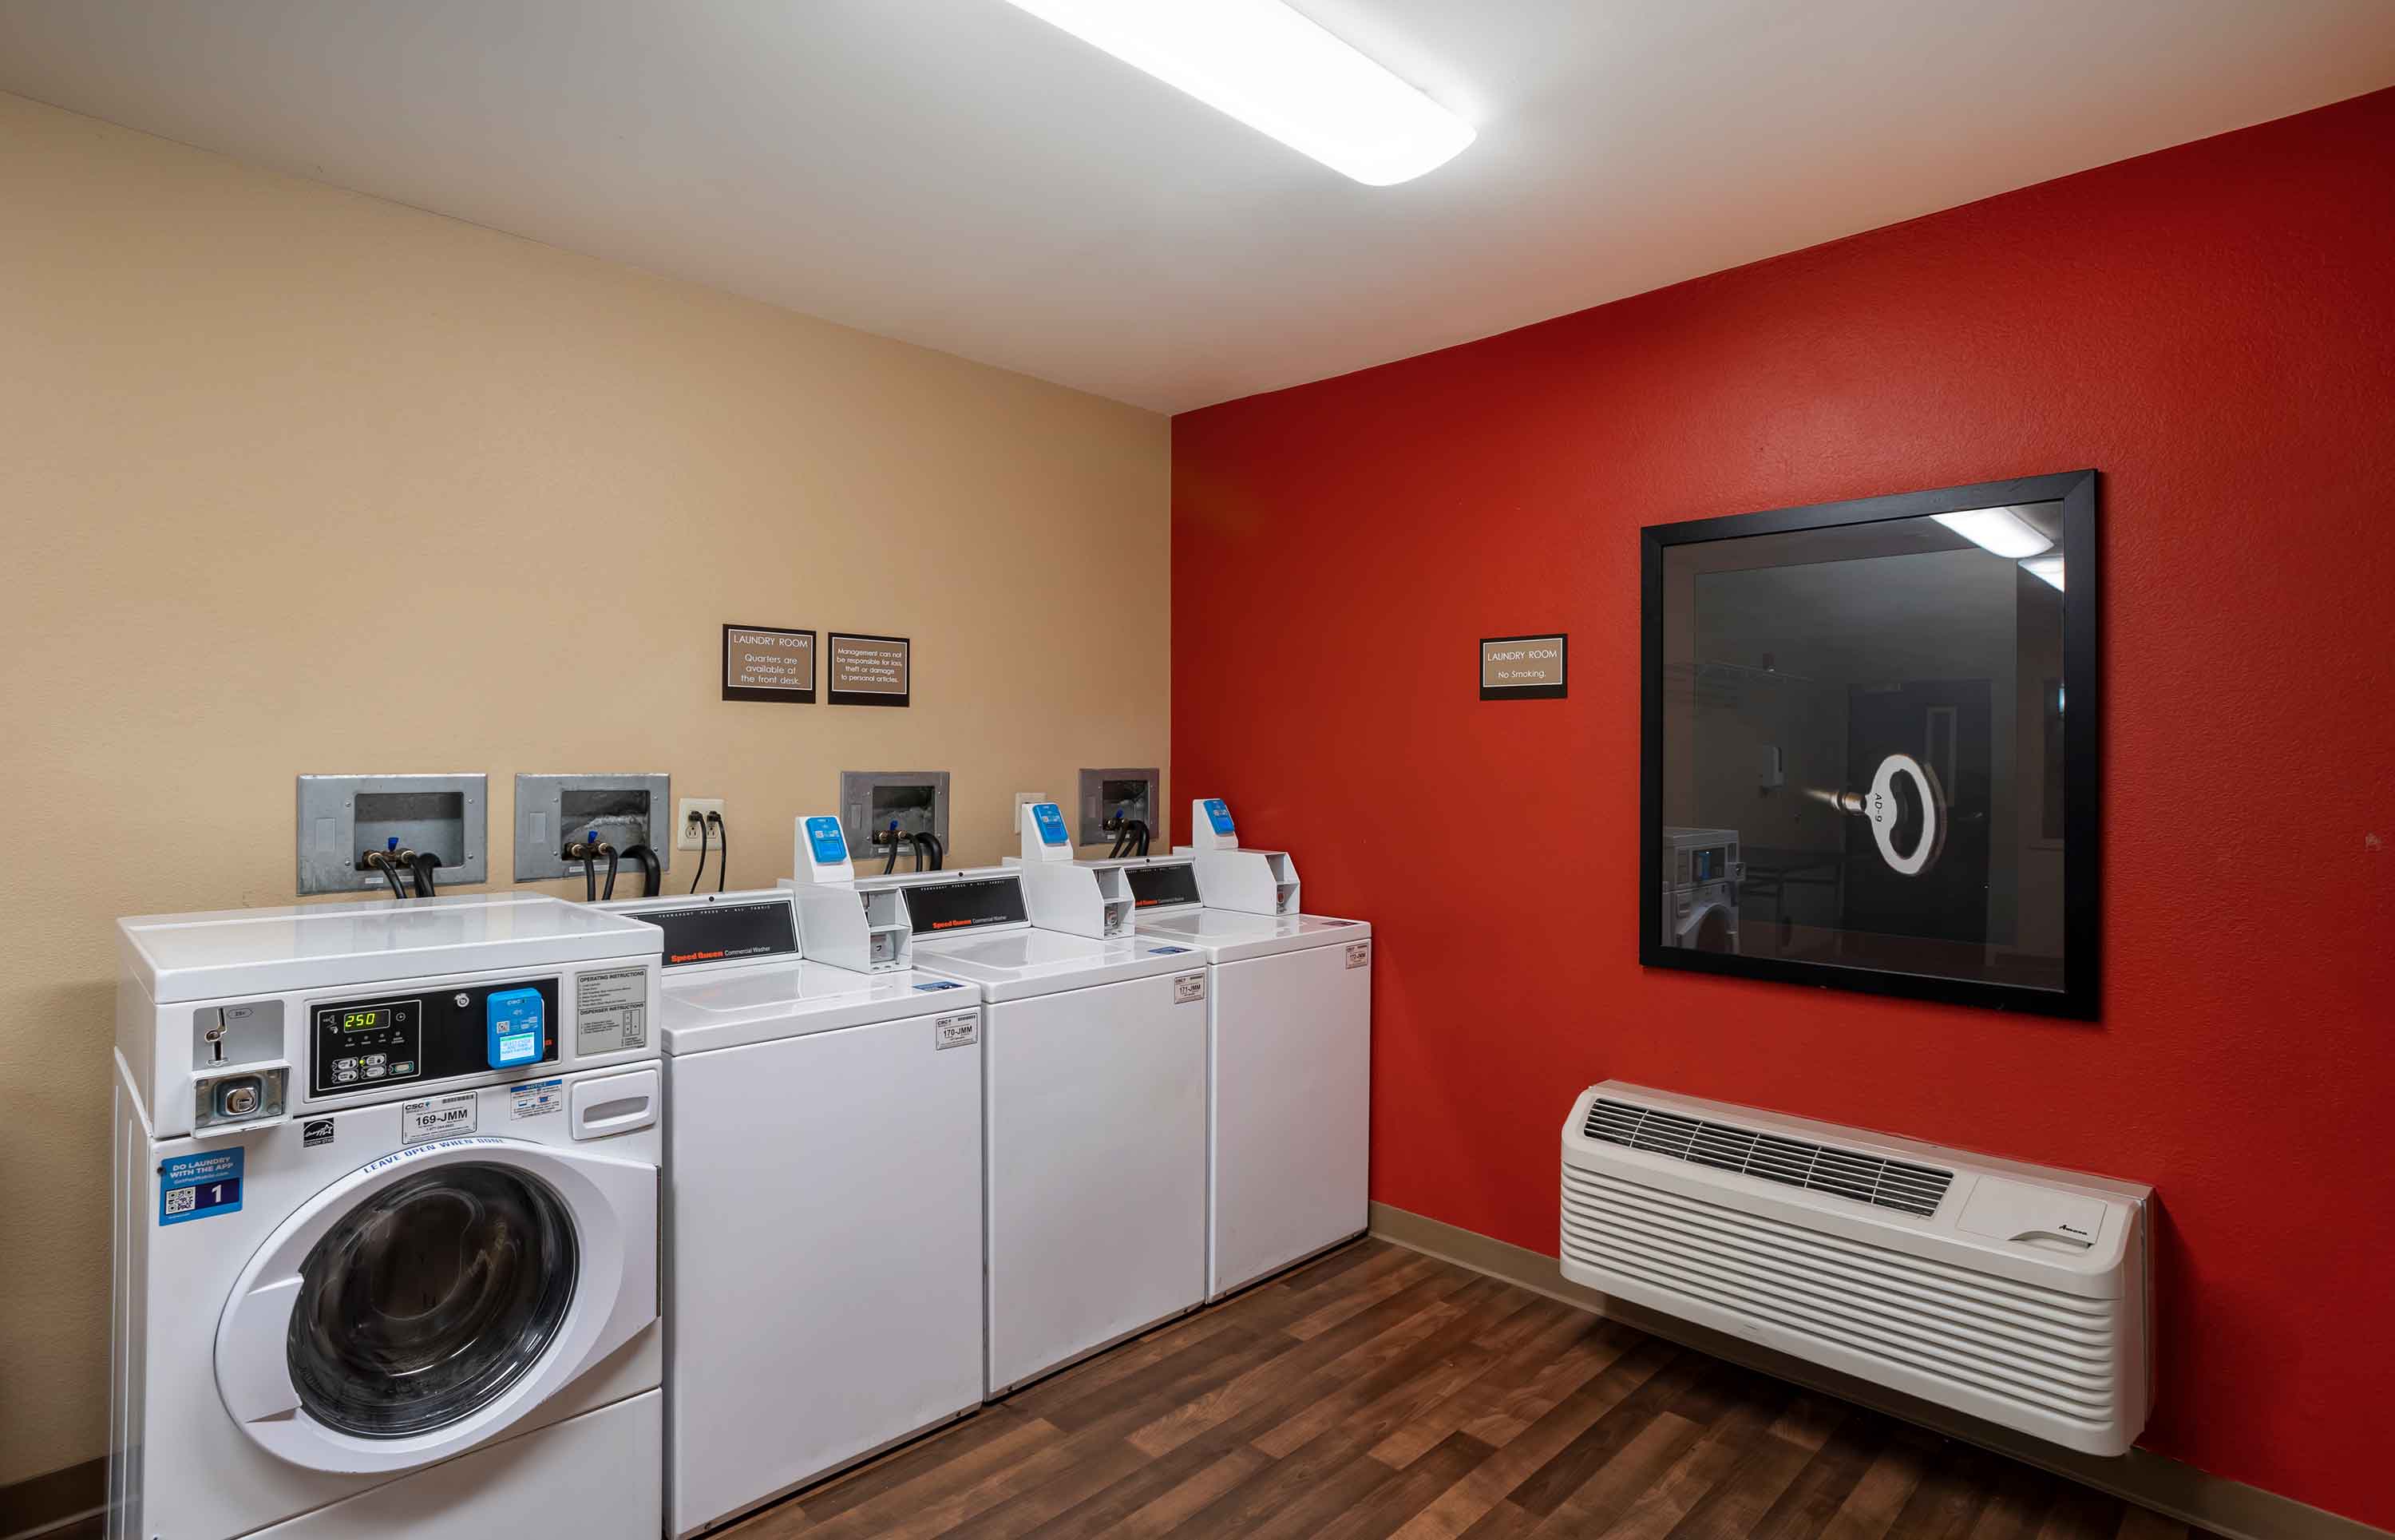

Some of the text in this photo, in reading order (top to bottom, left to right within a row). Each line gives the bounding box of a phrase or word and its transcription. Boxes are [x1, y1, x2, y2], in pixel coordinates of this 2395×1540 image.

[734, 635, 808, 648] LAUNDRY ROOM
[837, 647, 878, 656] Management
[1487, 651, 1525, 661] LAUNDRY
[745, 653, 781, 663] Quarters
[746, 665, 785, 674] available
[869, 667, 894, 675] damage
[932, 920, 952, 929] Speed
[671, 952, 697, 963] Speed
[698, 950, 723, 959] Queen
[724, 947, 752, 956] Commercial
[609, 1003, 644, 1011] INSTRUCTIONS
[345, 1013, 375, 1027] 250
[944, 1026, 972, 1037] 170-JMM
[415, 1110, 468, 1126] 169-JMM
[363, 1155, 402, 1174] LEAVE
[404, 1144, 436, 1157] OPEN
[440, 1138, 473, 1147] WHEN
[188, 1157, 231, 1169] LAUNDRY
[170, 1169, 194, 1178] WITH
[212, 1185, 222, 1203] 1
